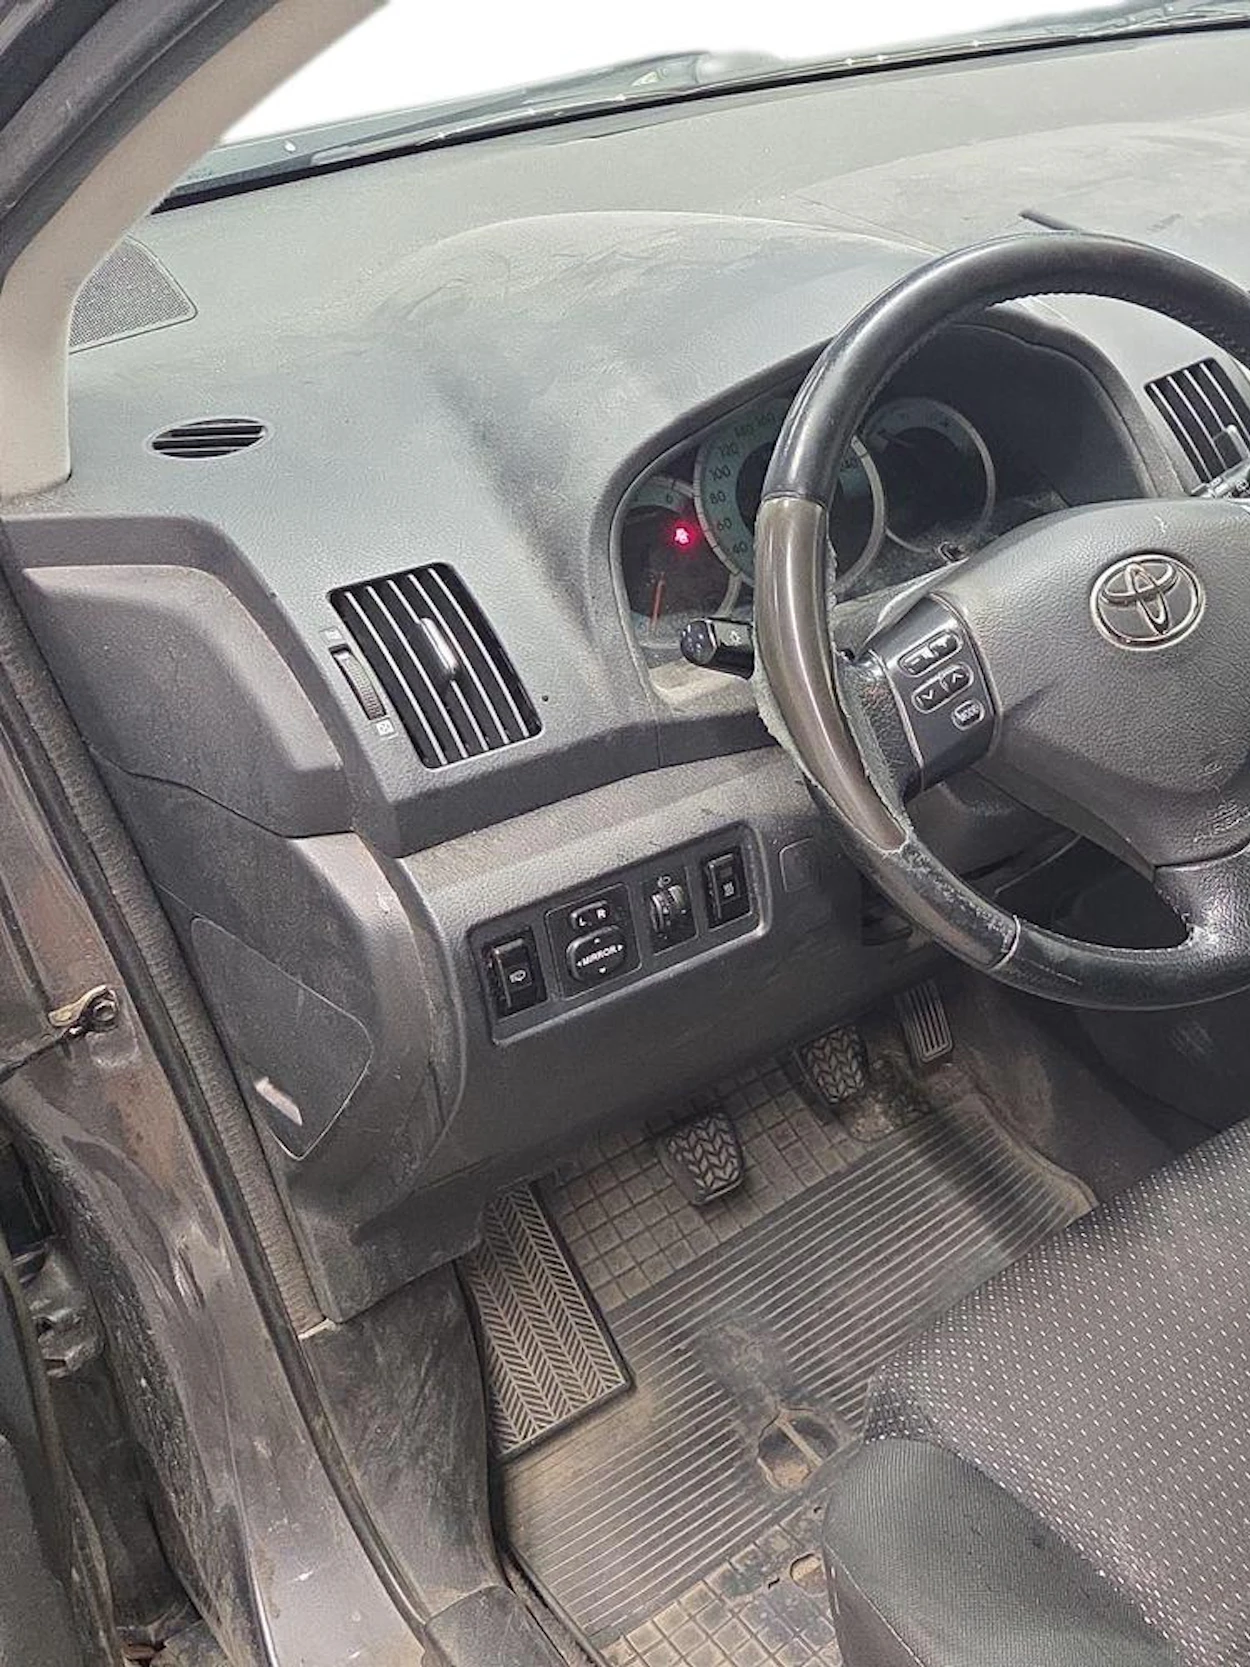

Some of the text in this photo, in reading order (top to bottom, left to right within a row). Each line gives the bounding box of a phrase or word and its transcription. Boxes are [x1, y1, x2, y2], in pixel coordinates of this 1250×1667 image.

[709, 464, 731, 481] 100
[709, 490, 726, 504] 80
[716, 517, 733, 532] 60
[579, 908, 607, 926] L R
[582, 944, 618, 966] MIRROR
